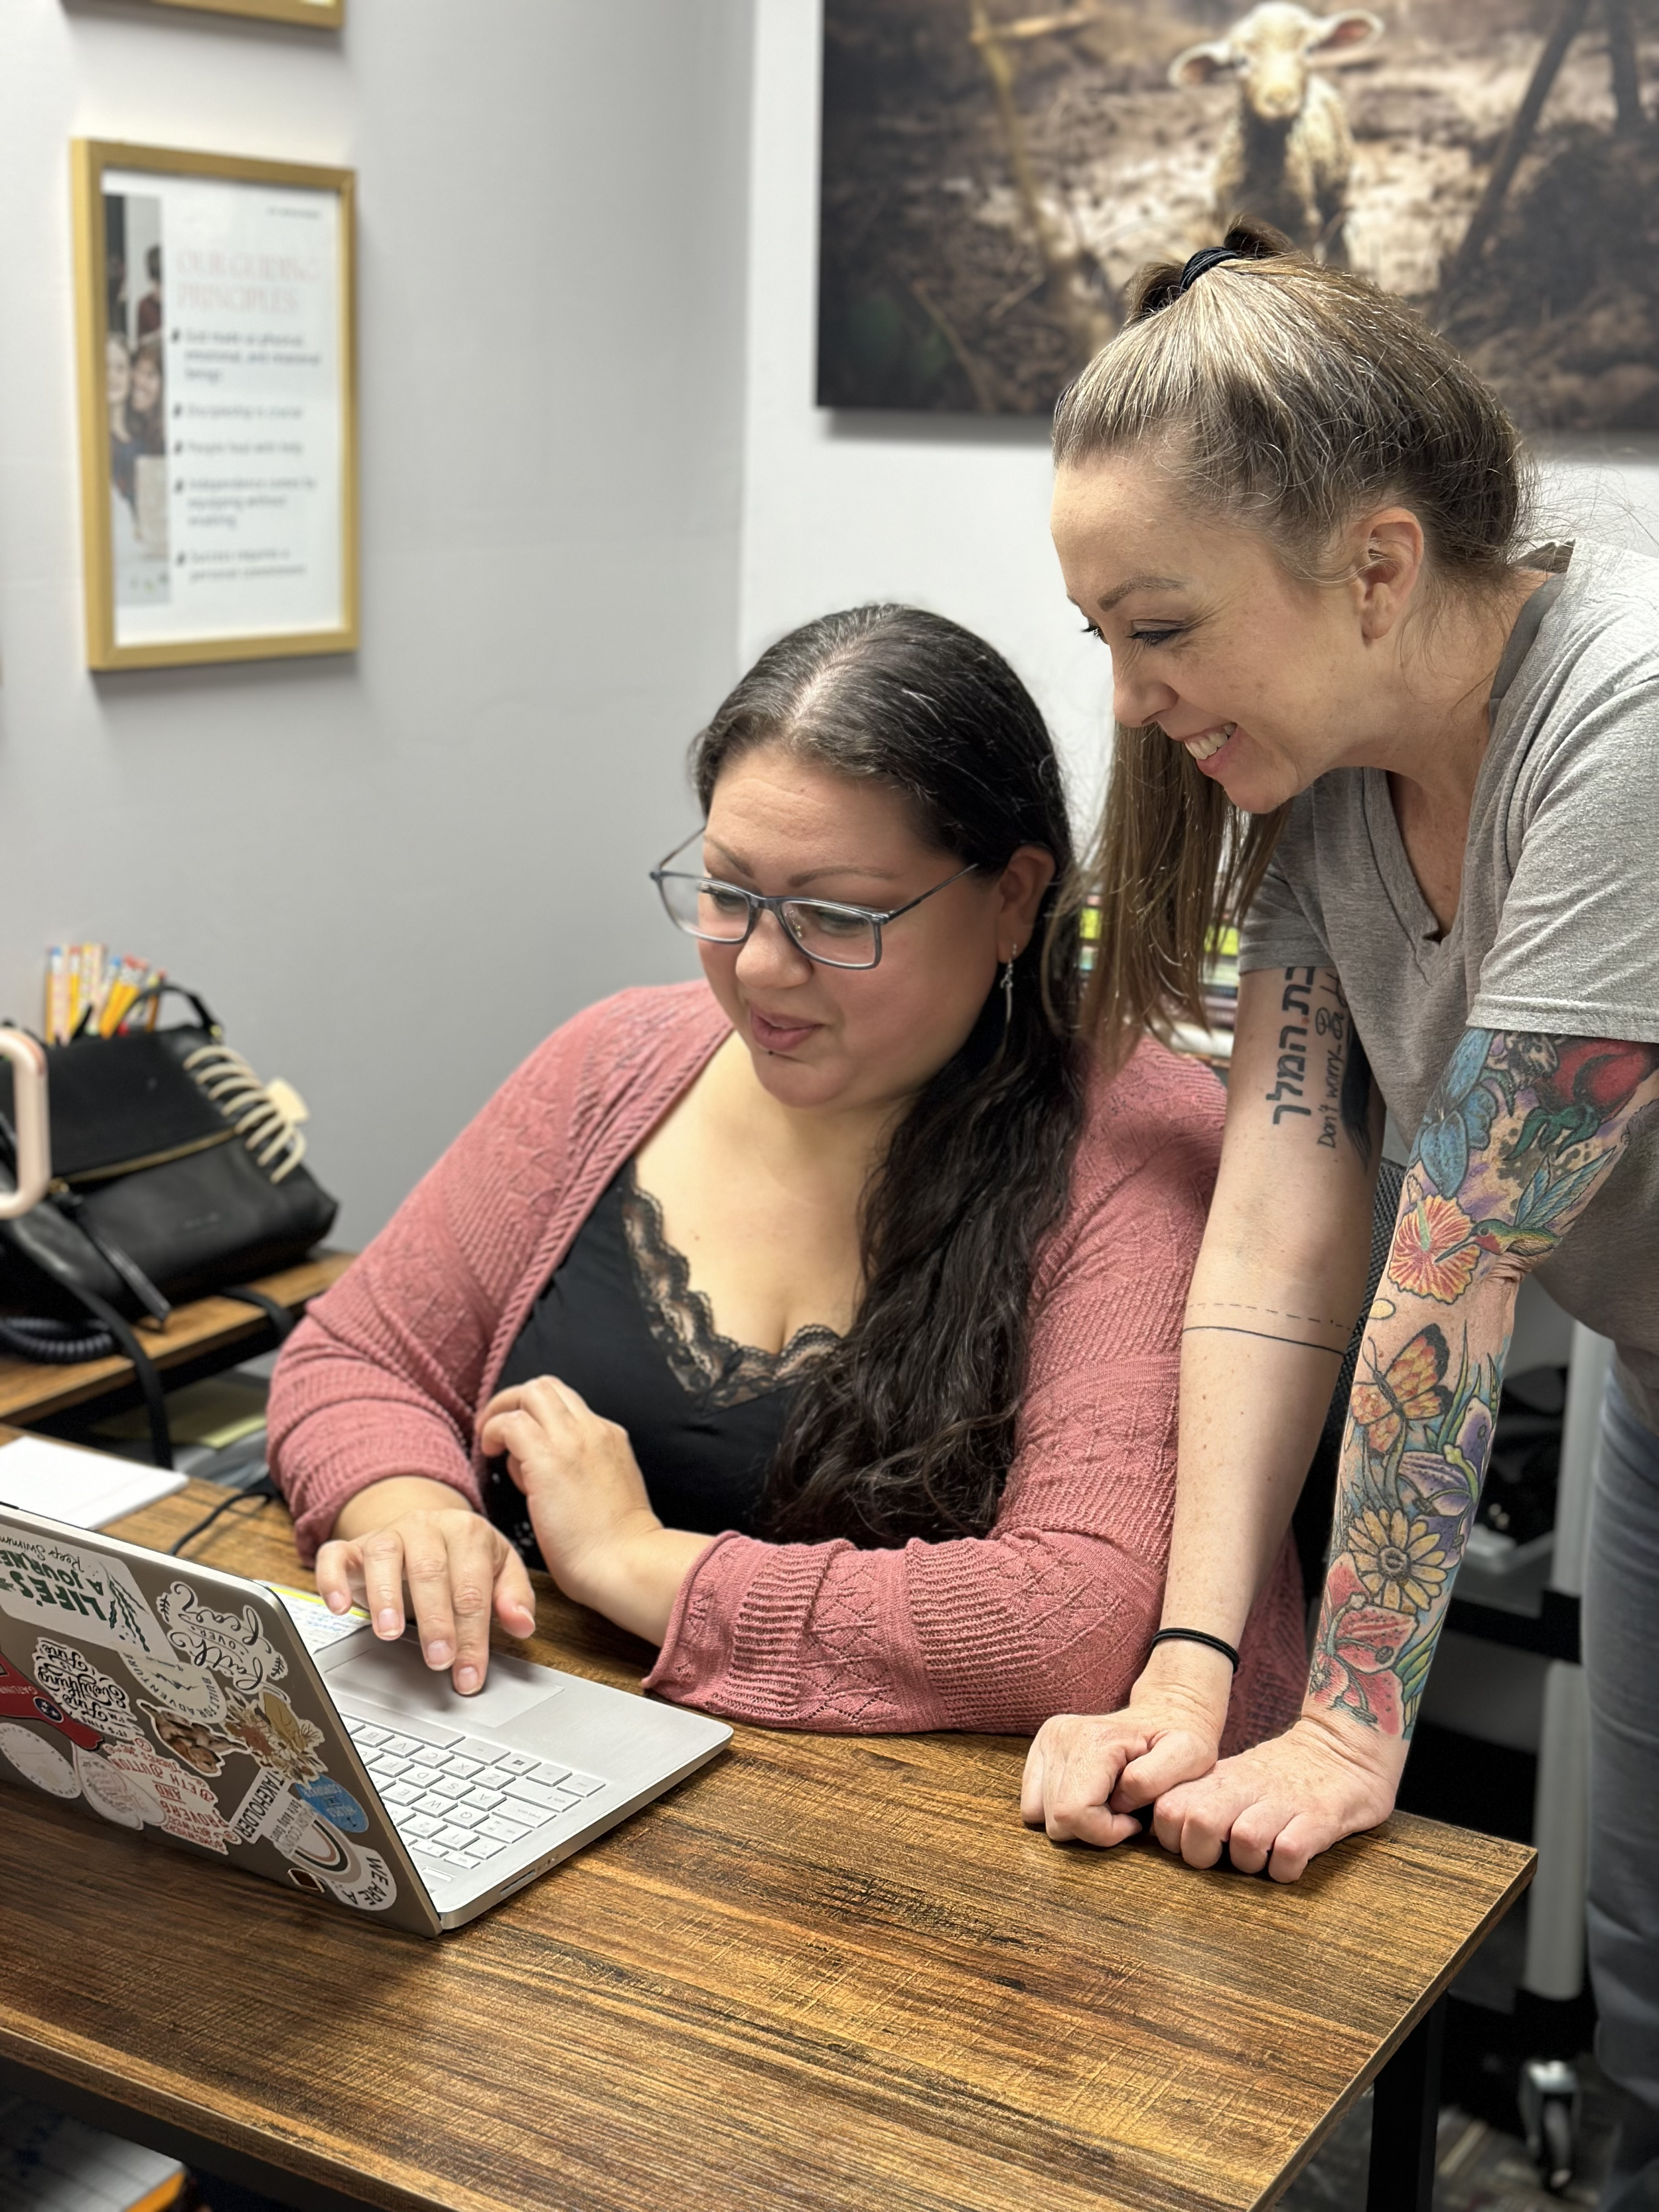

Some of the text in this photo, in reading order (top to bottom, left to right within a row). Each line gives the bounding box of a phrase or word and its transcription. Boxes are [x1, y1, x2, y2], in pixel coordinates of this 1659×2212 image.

[1317, 1104, 1337, 1149] Don't
[10, 1570, 107, 1621] LIFE'S
[85, 1578, 105, 1597] A
[196, 1628, 237, 1650] OVER
[123, 1653, 220, 1719] BUILT FOR ADVENTURE
[155, 1783, 182, 1801] AND
[460, 1811, 472, 1820] Q
[341, 1856, 389, 1905] WE ARE A
